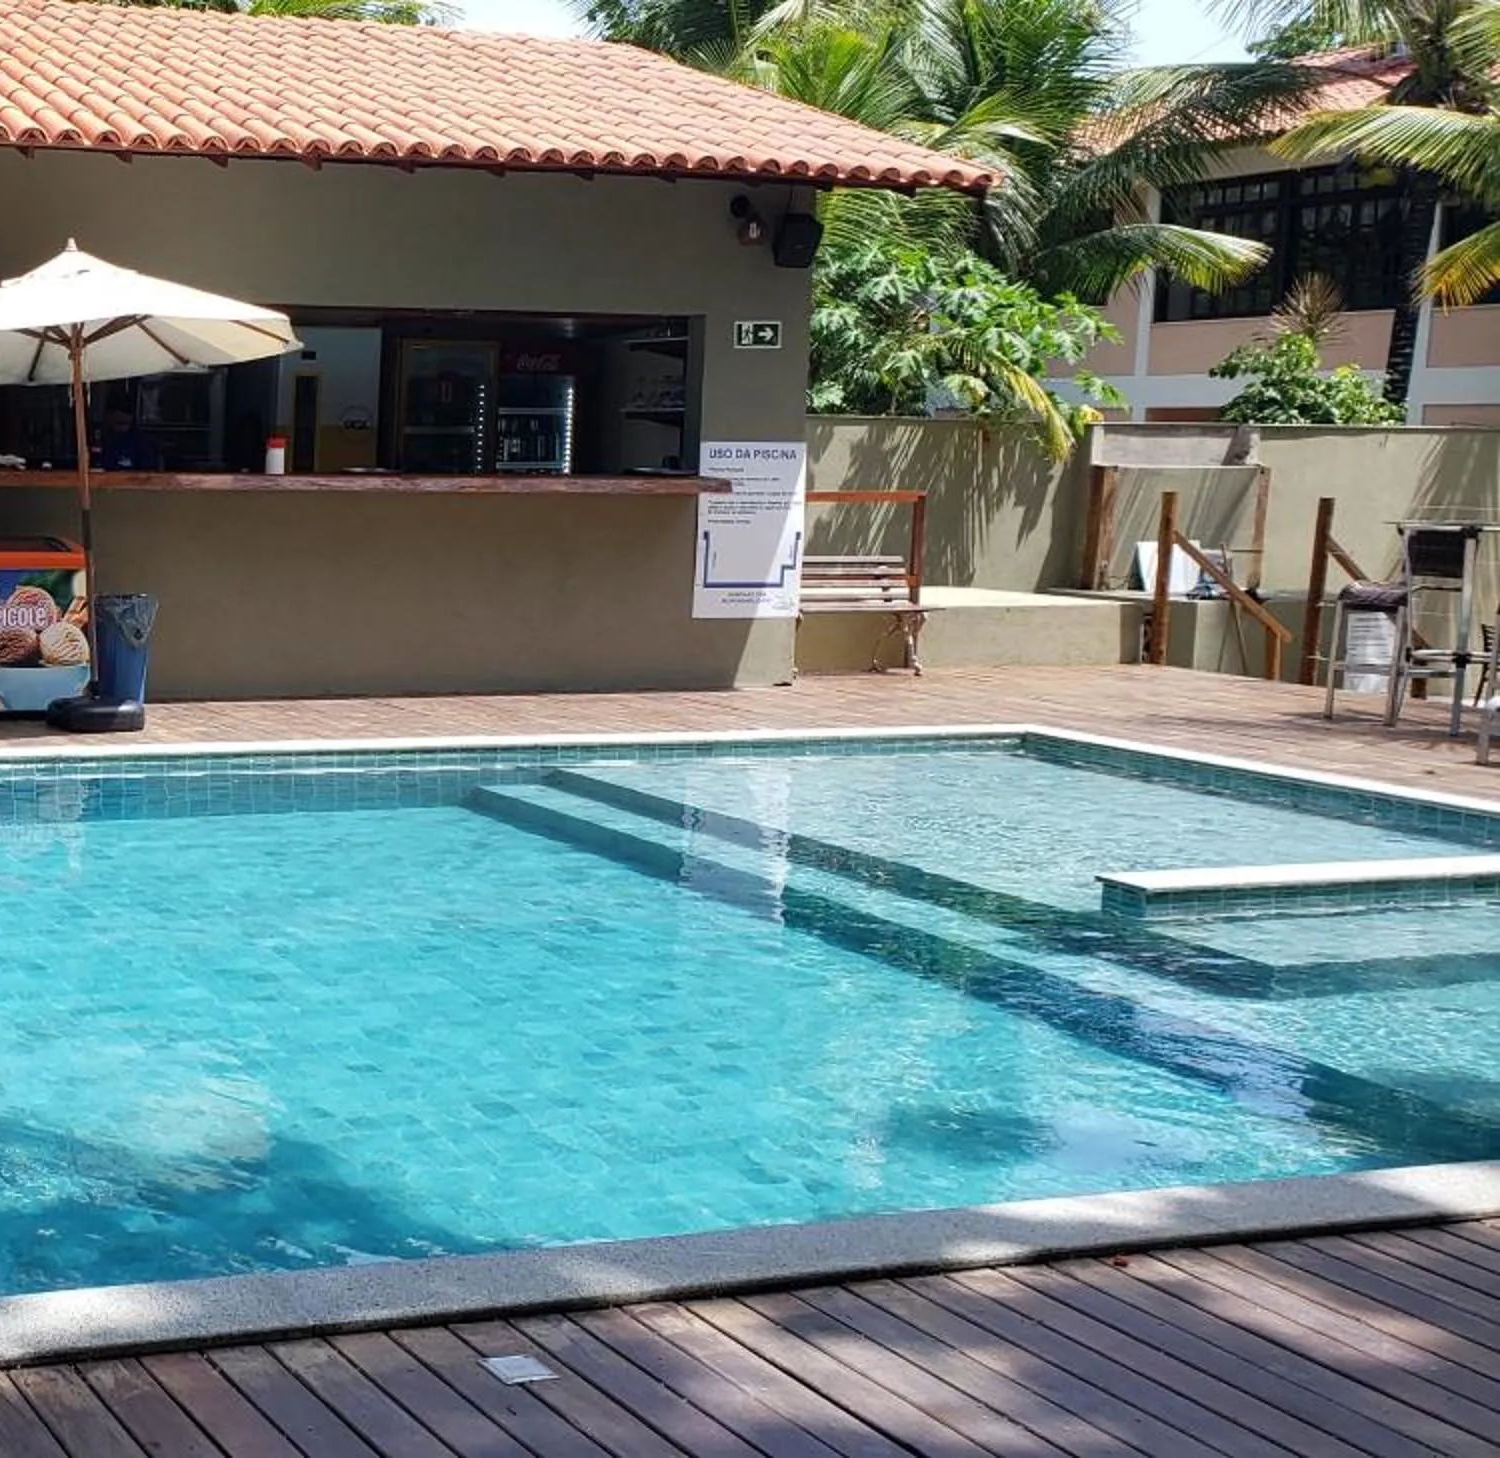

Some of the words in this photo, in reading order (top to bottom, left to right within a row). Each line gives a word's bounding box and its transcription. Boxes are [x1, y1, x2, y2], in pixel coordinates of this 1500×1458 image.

[709, 448, 732, 459] USO
[735, 448, 751, 459] DA
[753, 449, 797, 460] PISCINA
